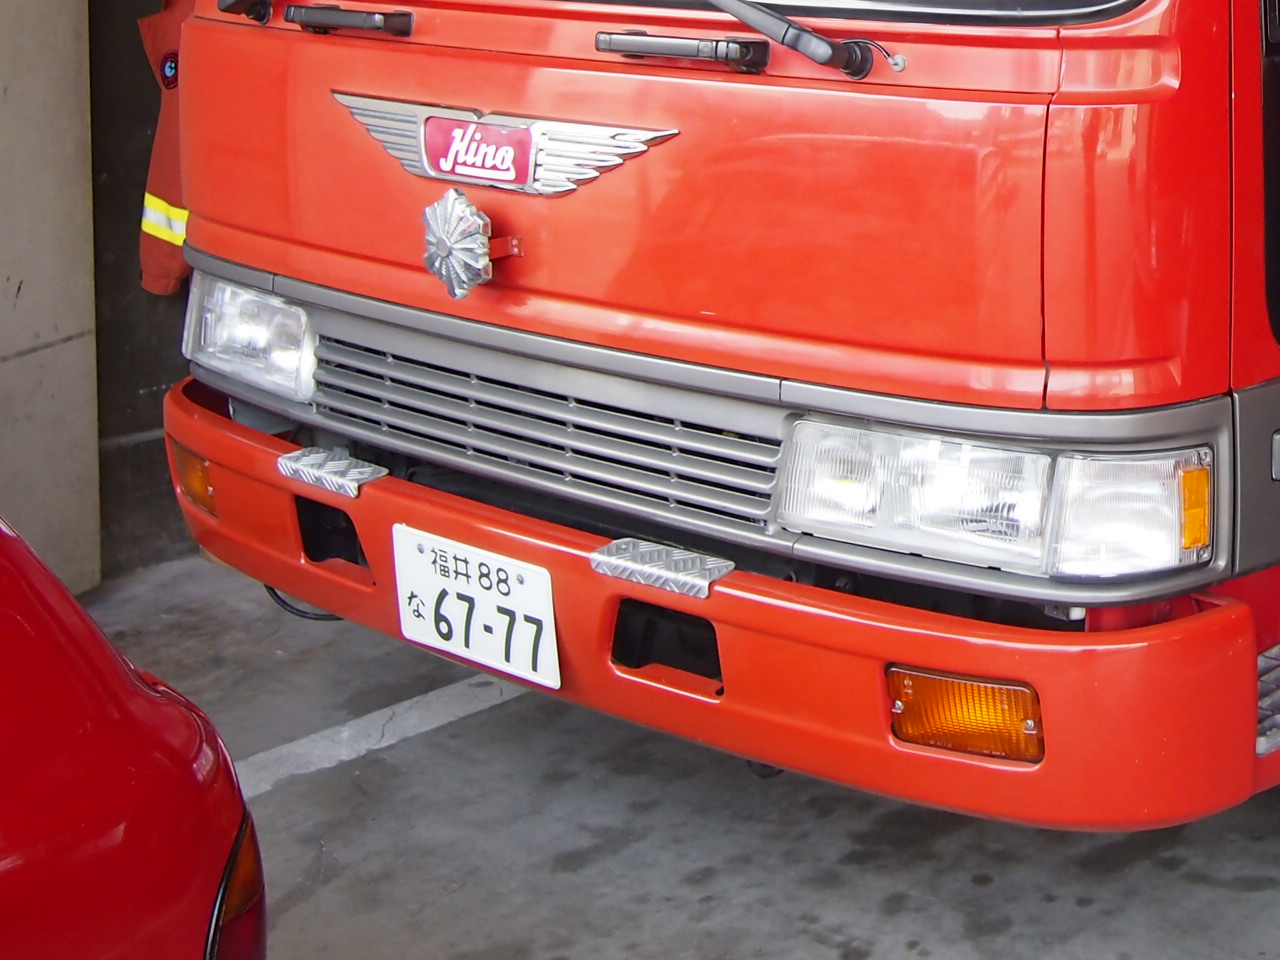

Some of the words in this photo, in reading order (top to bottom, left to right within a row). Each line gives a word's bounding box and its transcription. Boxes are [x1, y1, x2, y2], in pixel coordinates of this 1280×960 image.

[439, 123, 516, 180] Hino
[407, 591, 426, 620] な
[434, 587, 544, 673] 67-77
